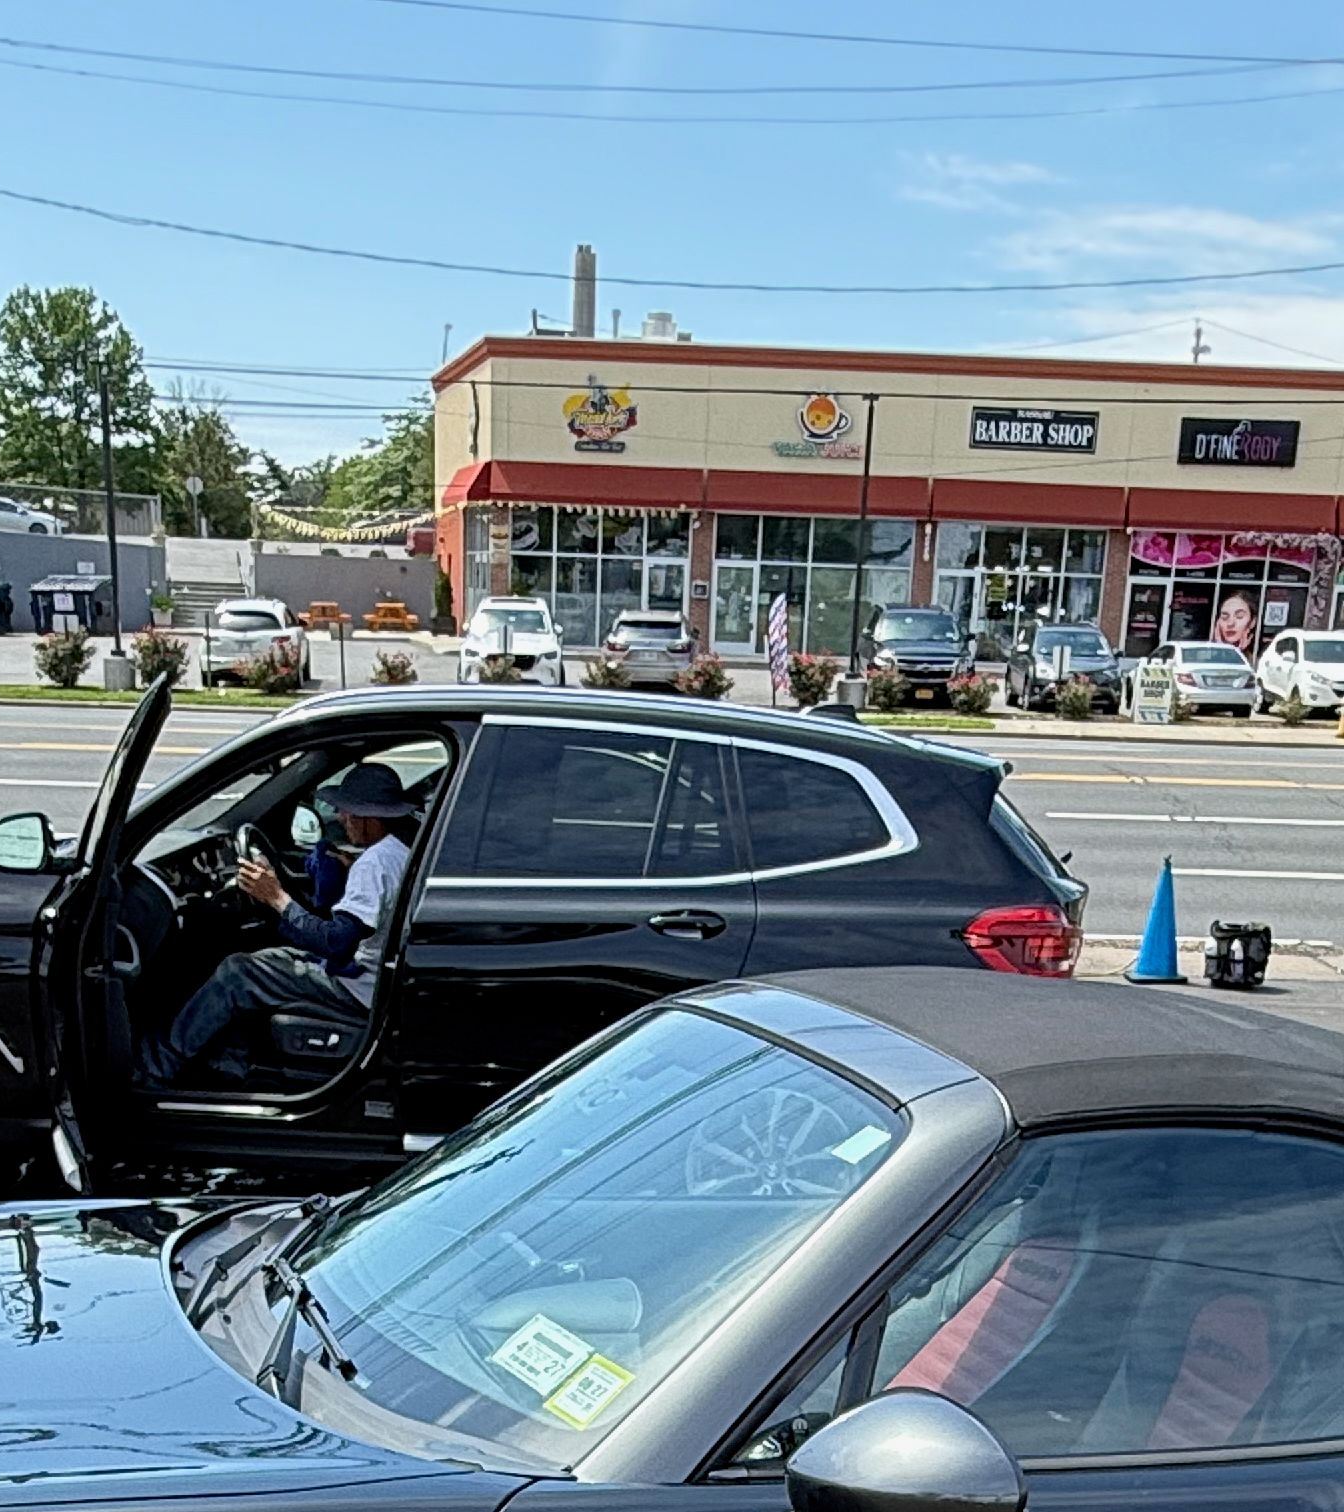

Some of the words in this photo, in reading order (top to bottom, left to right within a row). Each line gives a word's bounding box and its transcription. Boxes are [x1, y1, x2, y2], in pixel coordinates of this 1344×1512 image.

[975, 420, 1044, 444] BARBER
[1047, 423, 1093, 446] SHOP
[1194, 433, 1240, 460] D'FINE
